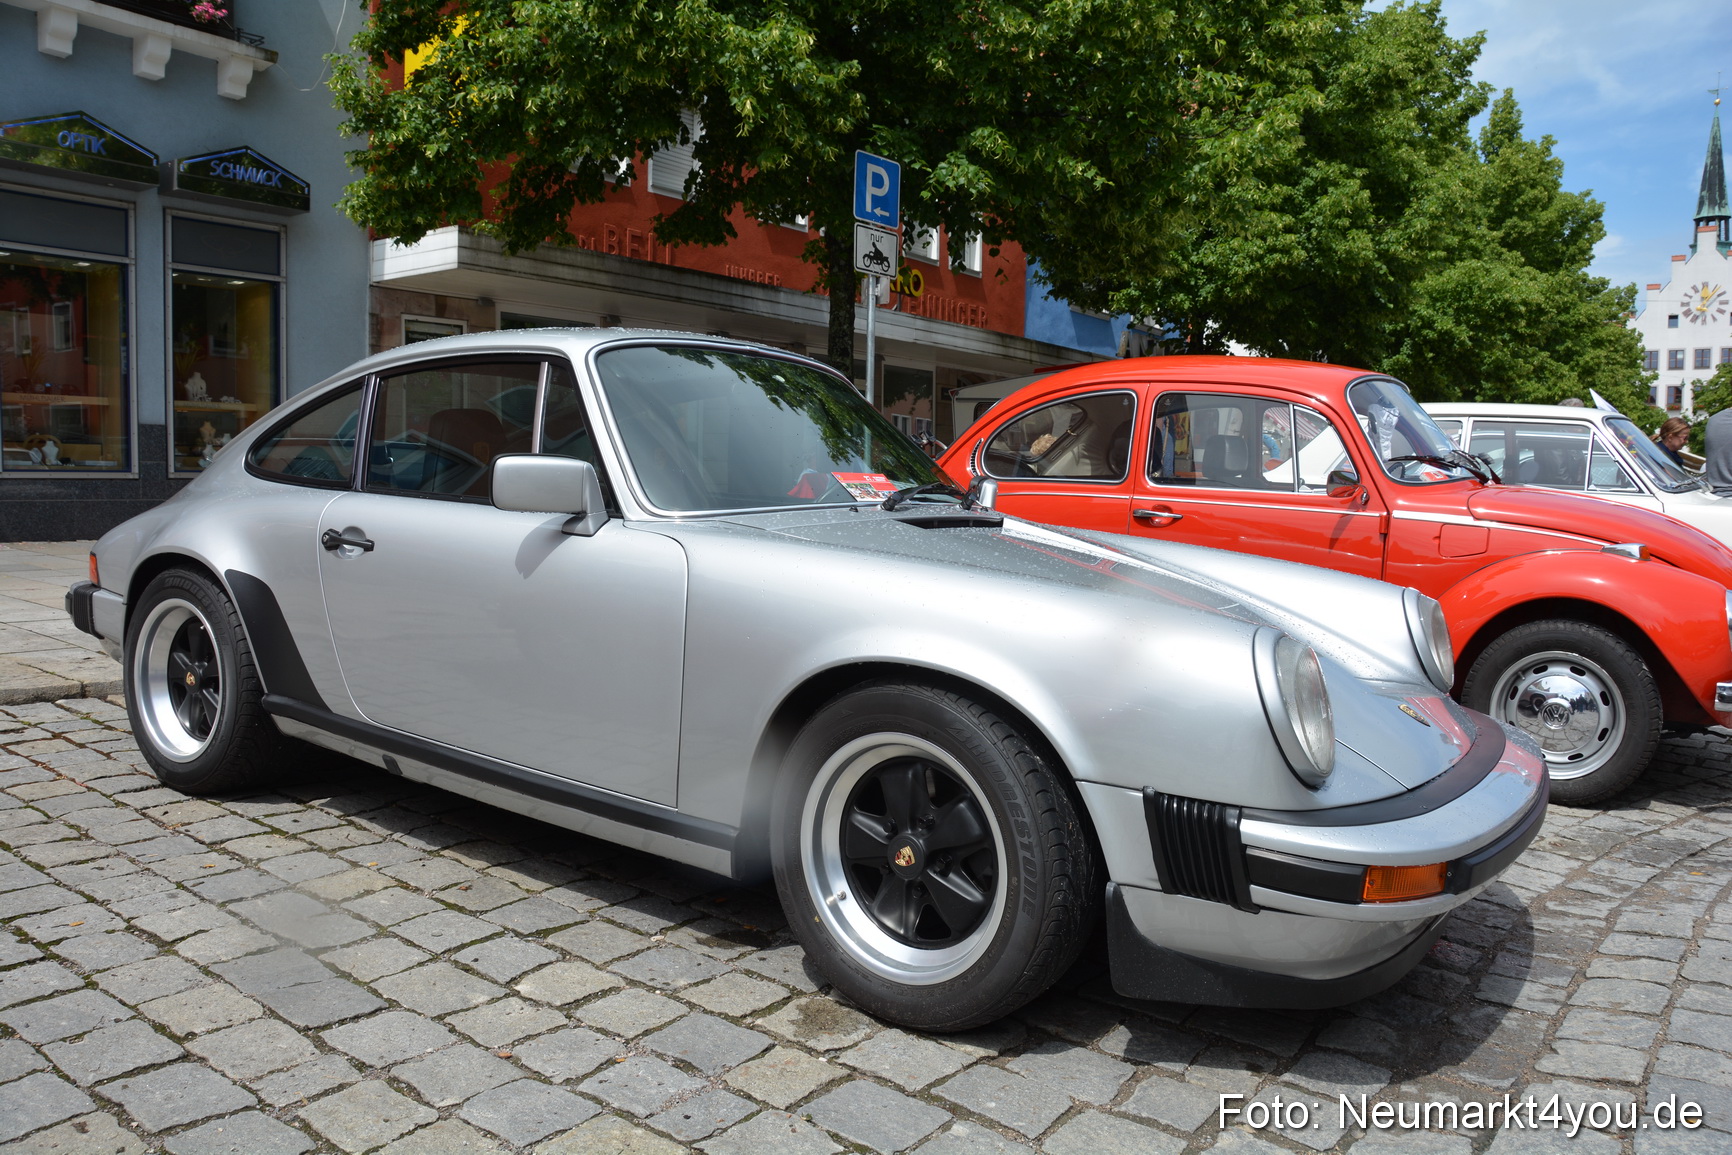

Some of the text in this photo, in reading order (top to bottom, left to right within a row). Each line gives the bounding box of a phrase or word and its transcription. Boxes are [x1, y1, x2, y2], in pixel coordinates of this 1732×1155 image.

[57, 130, 107, 155] OPTIK
[865, 162, 890, 213] P
[870, 232, 884, 243] nur
[946, 726, 1039, 920] BRIDGESTONE
